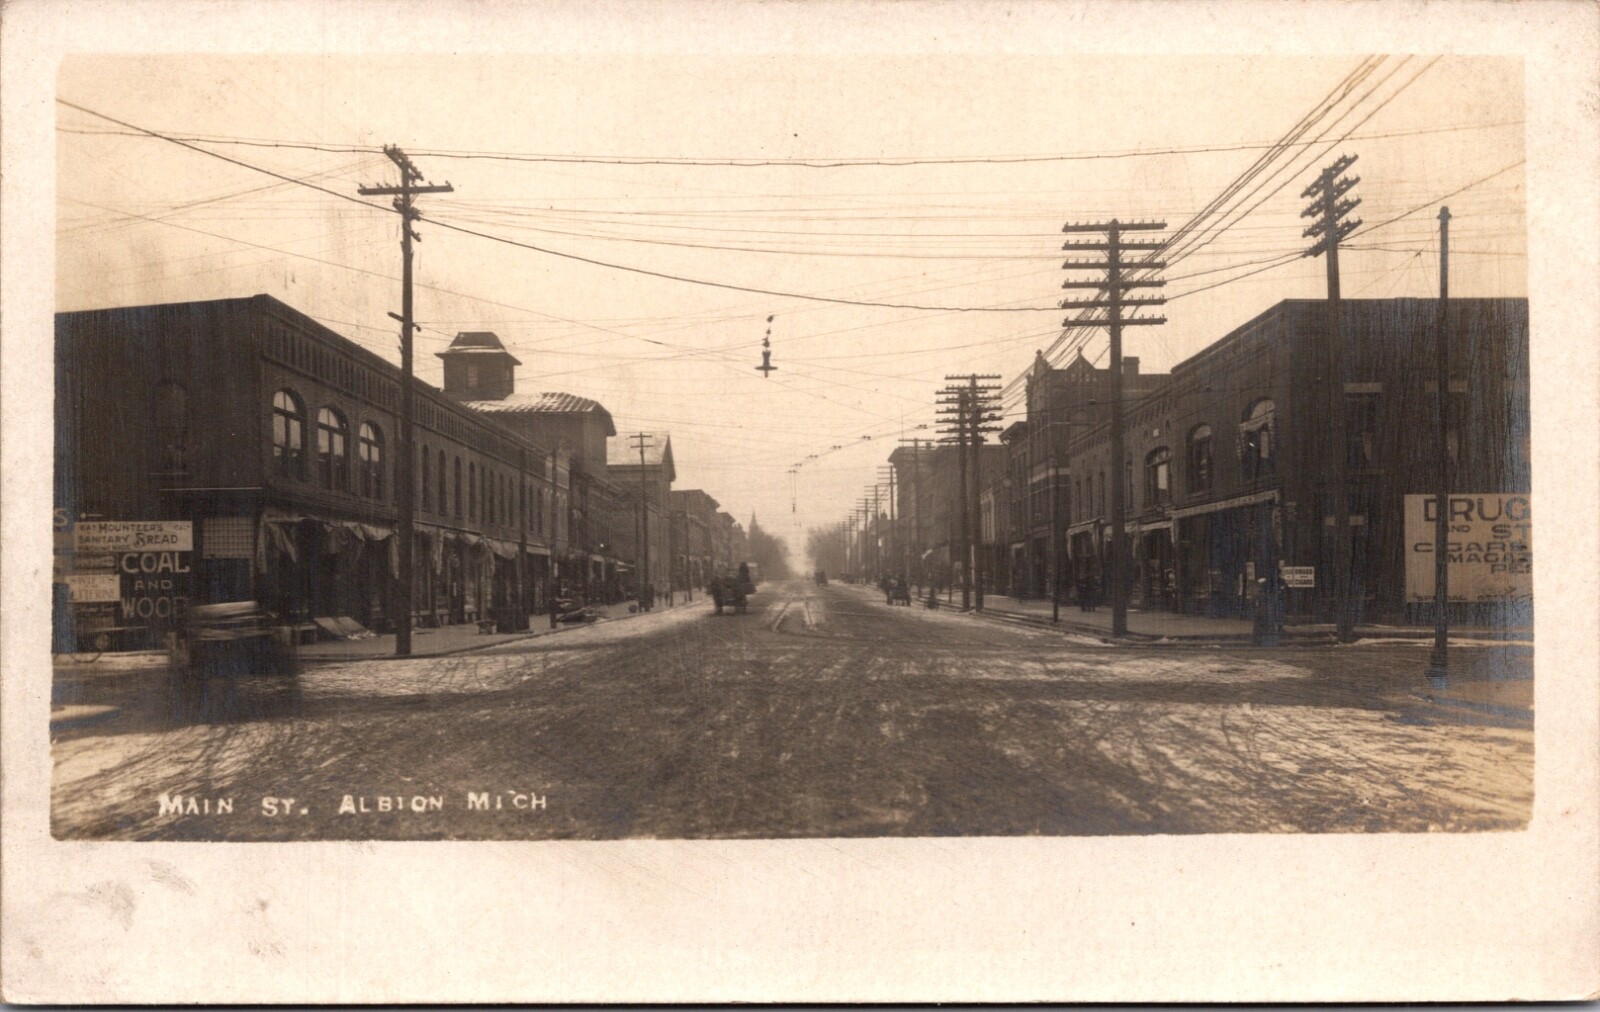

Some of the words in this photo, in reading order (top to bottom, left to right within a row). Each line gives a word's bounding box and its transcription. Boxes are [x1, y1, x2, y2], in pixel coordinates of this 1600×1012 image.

[133, 533, 178, 548] BREAD
[1413, 542, 1528, 552] CGARS
[121, 552, 191, 573] COAL
[134, 580, 172, 591] AND
